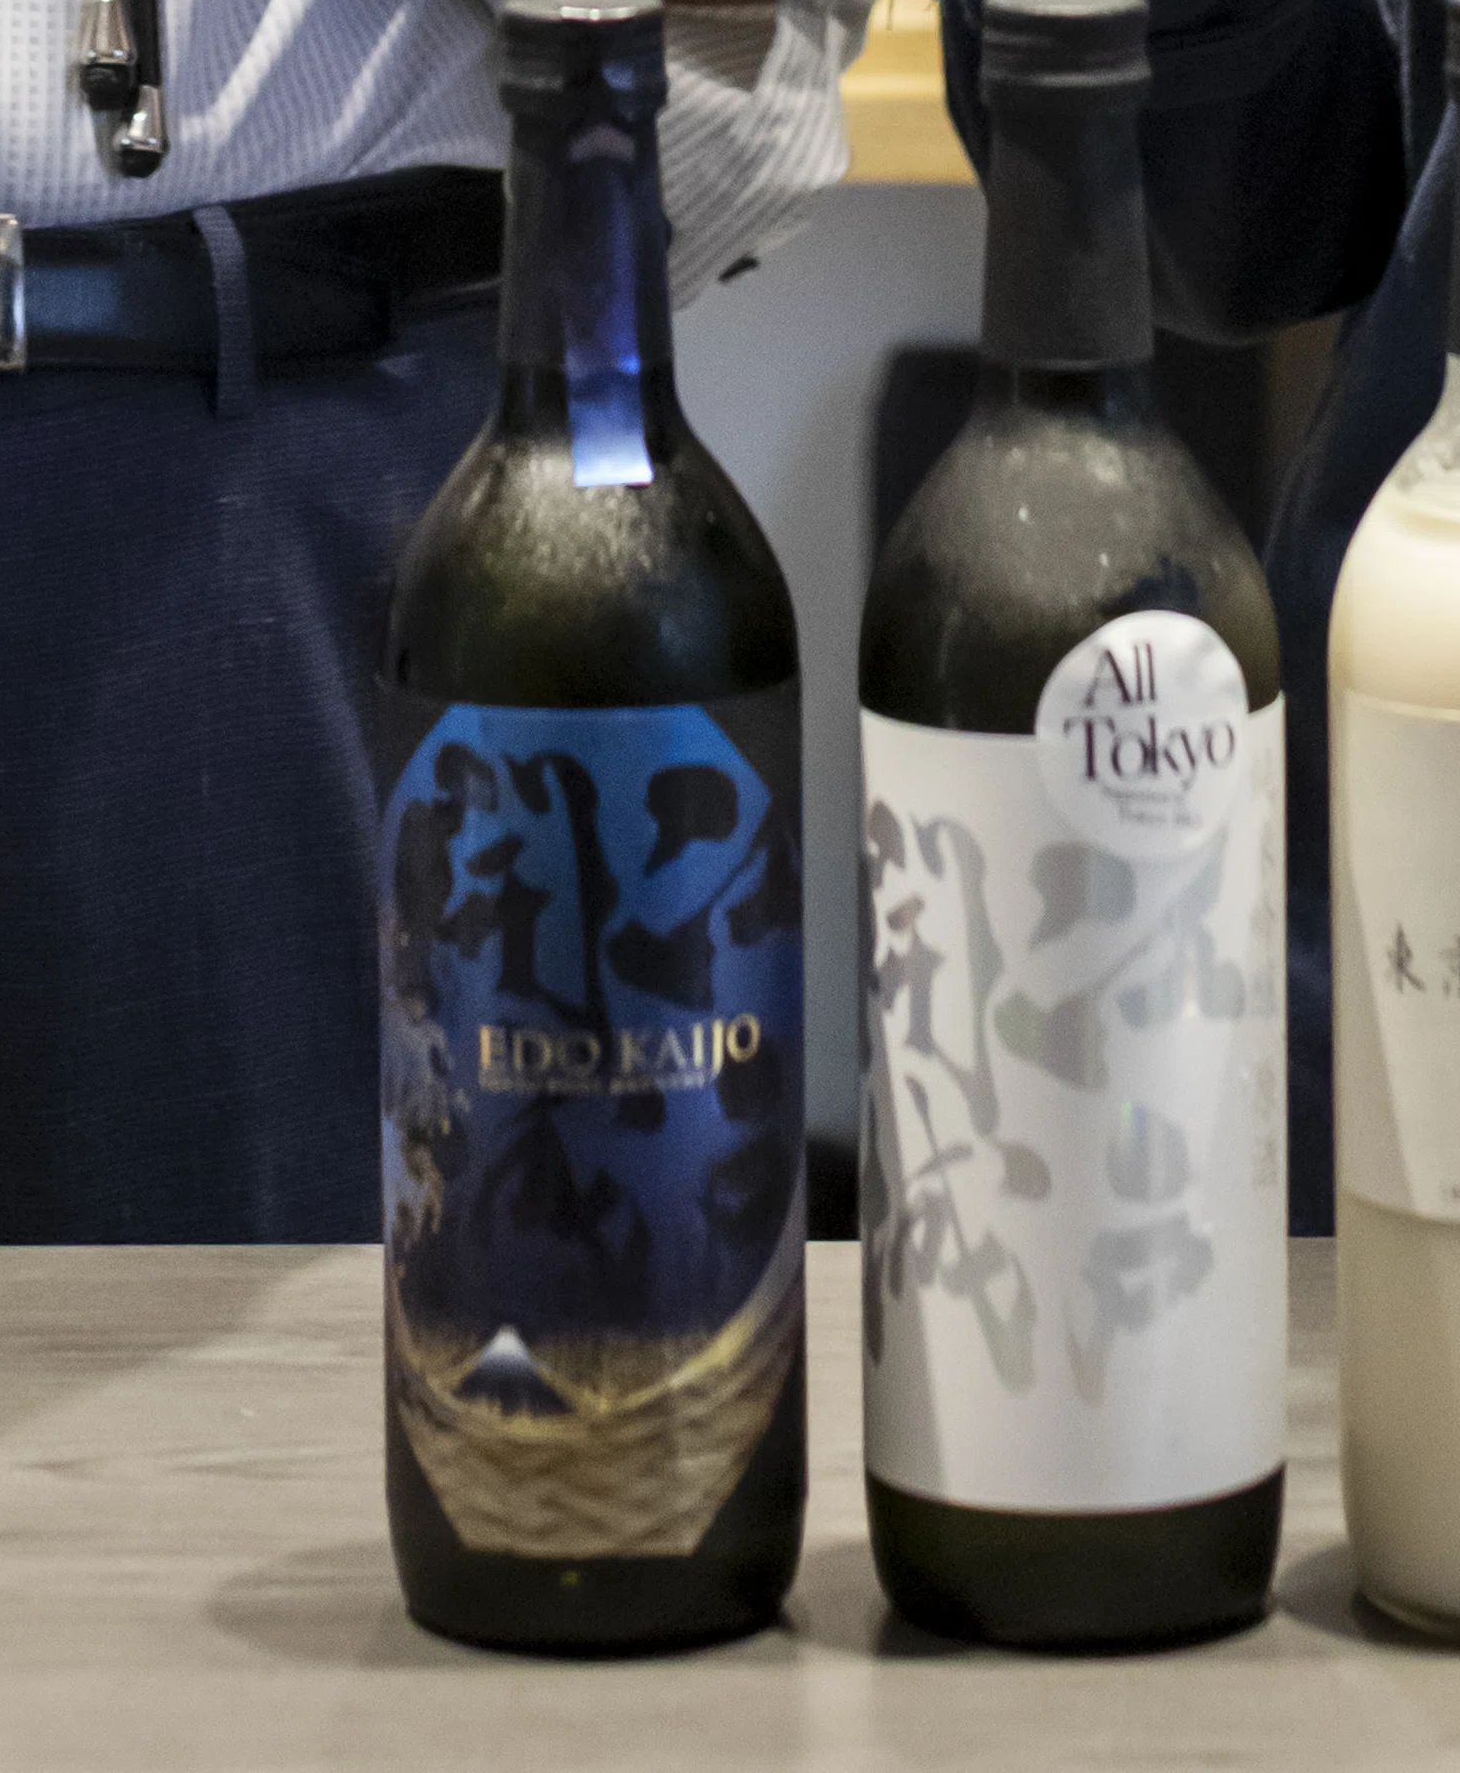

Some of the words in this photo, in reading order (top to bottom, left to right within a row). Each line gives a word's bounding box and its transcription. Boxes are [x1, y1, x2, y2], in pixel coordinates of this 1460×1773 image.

[1081, 641, 1157, 710] All
[1062, 713, 1236, 791] Tokyo
[478, 1025, 602, 1074] EDO
[620, 1012, 761, 1081] KAIJO
